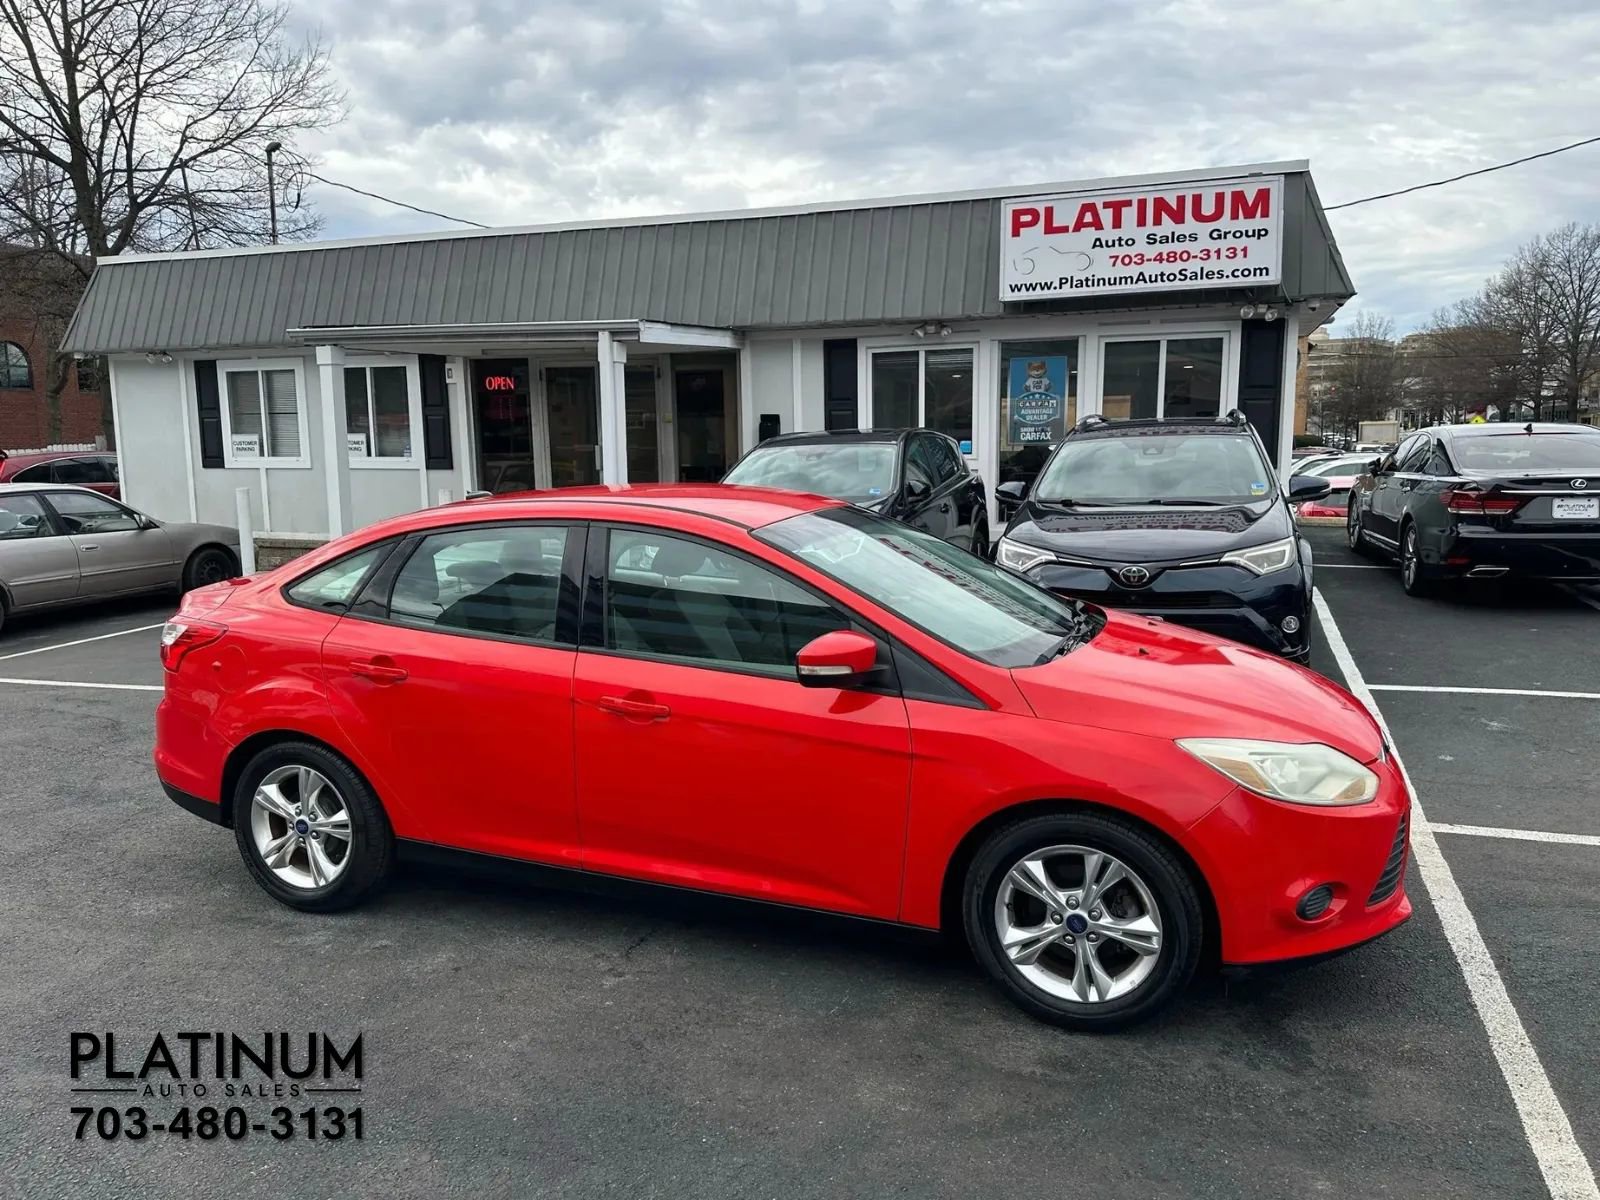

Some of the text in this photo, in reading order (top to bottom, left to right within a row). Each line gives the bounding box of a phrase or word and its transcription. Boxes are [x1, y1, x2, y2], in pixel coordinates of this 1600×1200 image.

[1011, 188, 1271, 237] PLATINUM
[1091, 226, 1269, 250] Auto Sales Group
[1109, 246, 1249, 267] 703-480-3131
[1009, 266, 1270, 294] www.PlatinumAutoSales.com
[485, 376, 515, 390] OPEN
[1020, 432, 1052, 440] CARFAX
